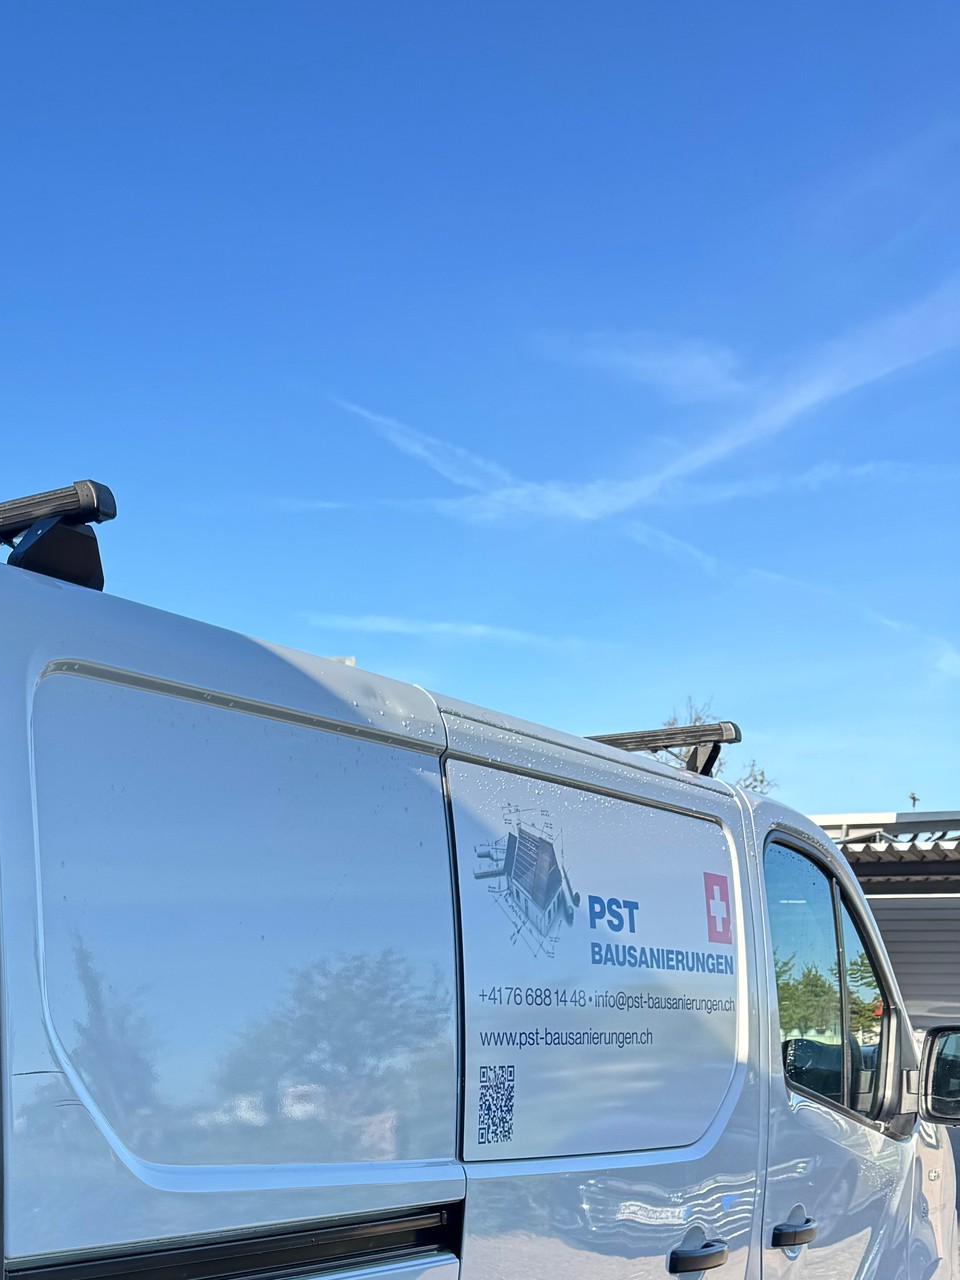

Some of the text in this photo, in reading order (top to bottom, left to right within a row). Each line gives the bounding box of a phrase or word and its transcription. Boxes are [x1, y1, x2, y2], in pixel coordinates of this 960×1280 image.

[588, 895, 639, 933] PST
[591, 942, 734, 975] BAUSANIERUNGEN
[594, 991, 736, 1014] info@pst-bausanierungen.ch
[479, 1027, 653, 1049] www.pst-bausanierungen.ch
